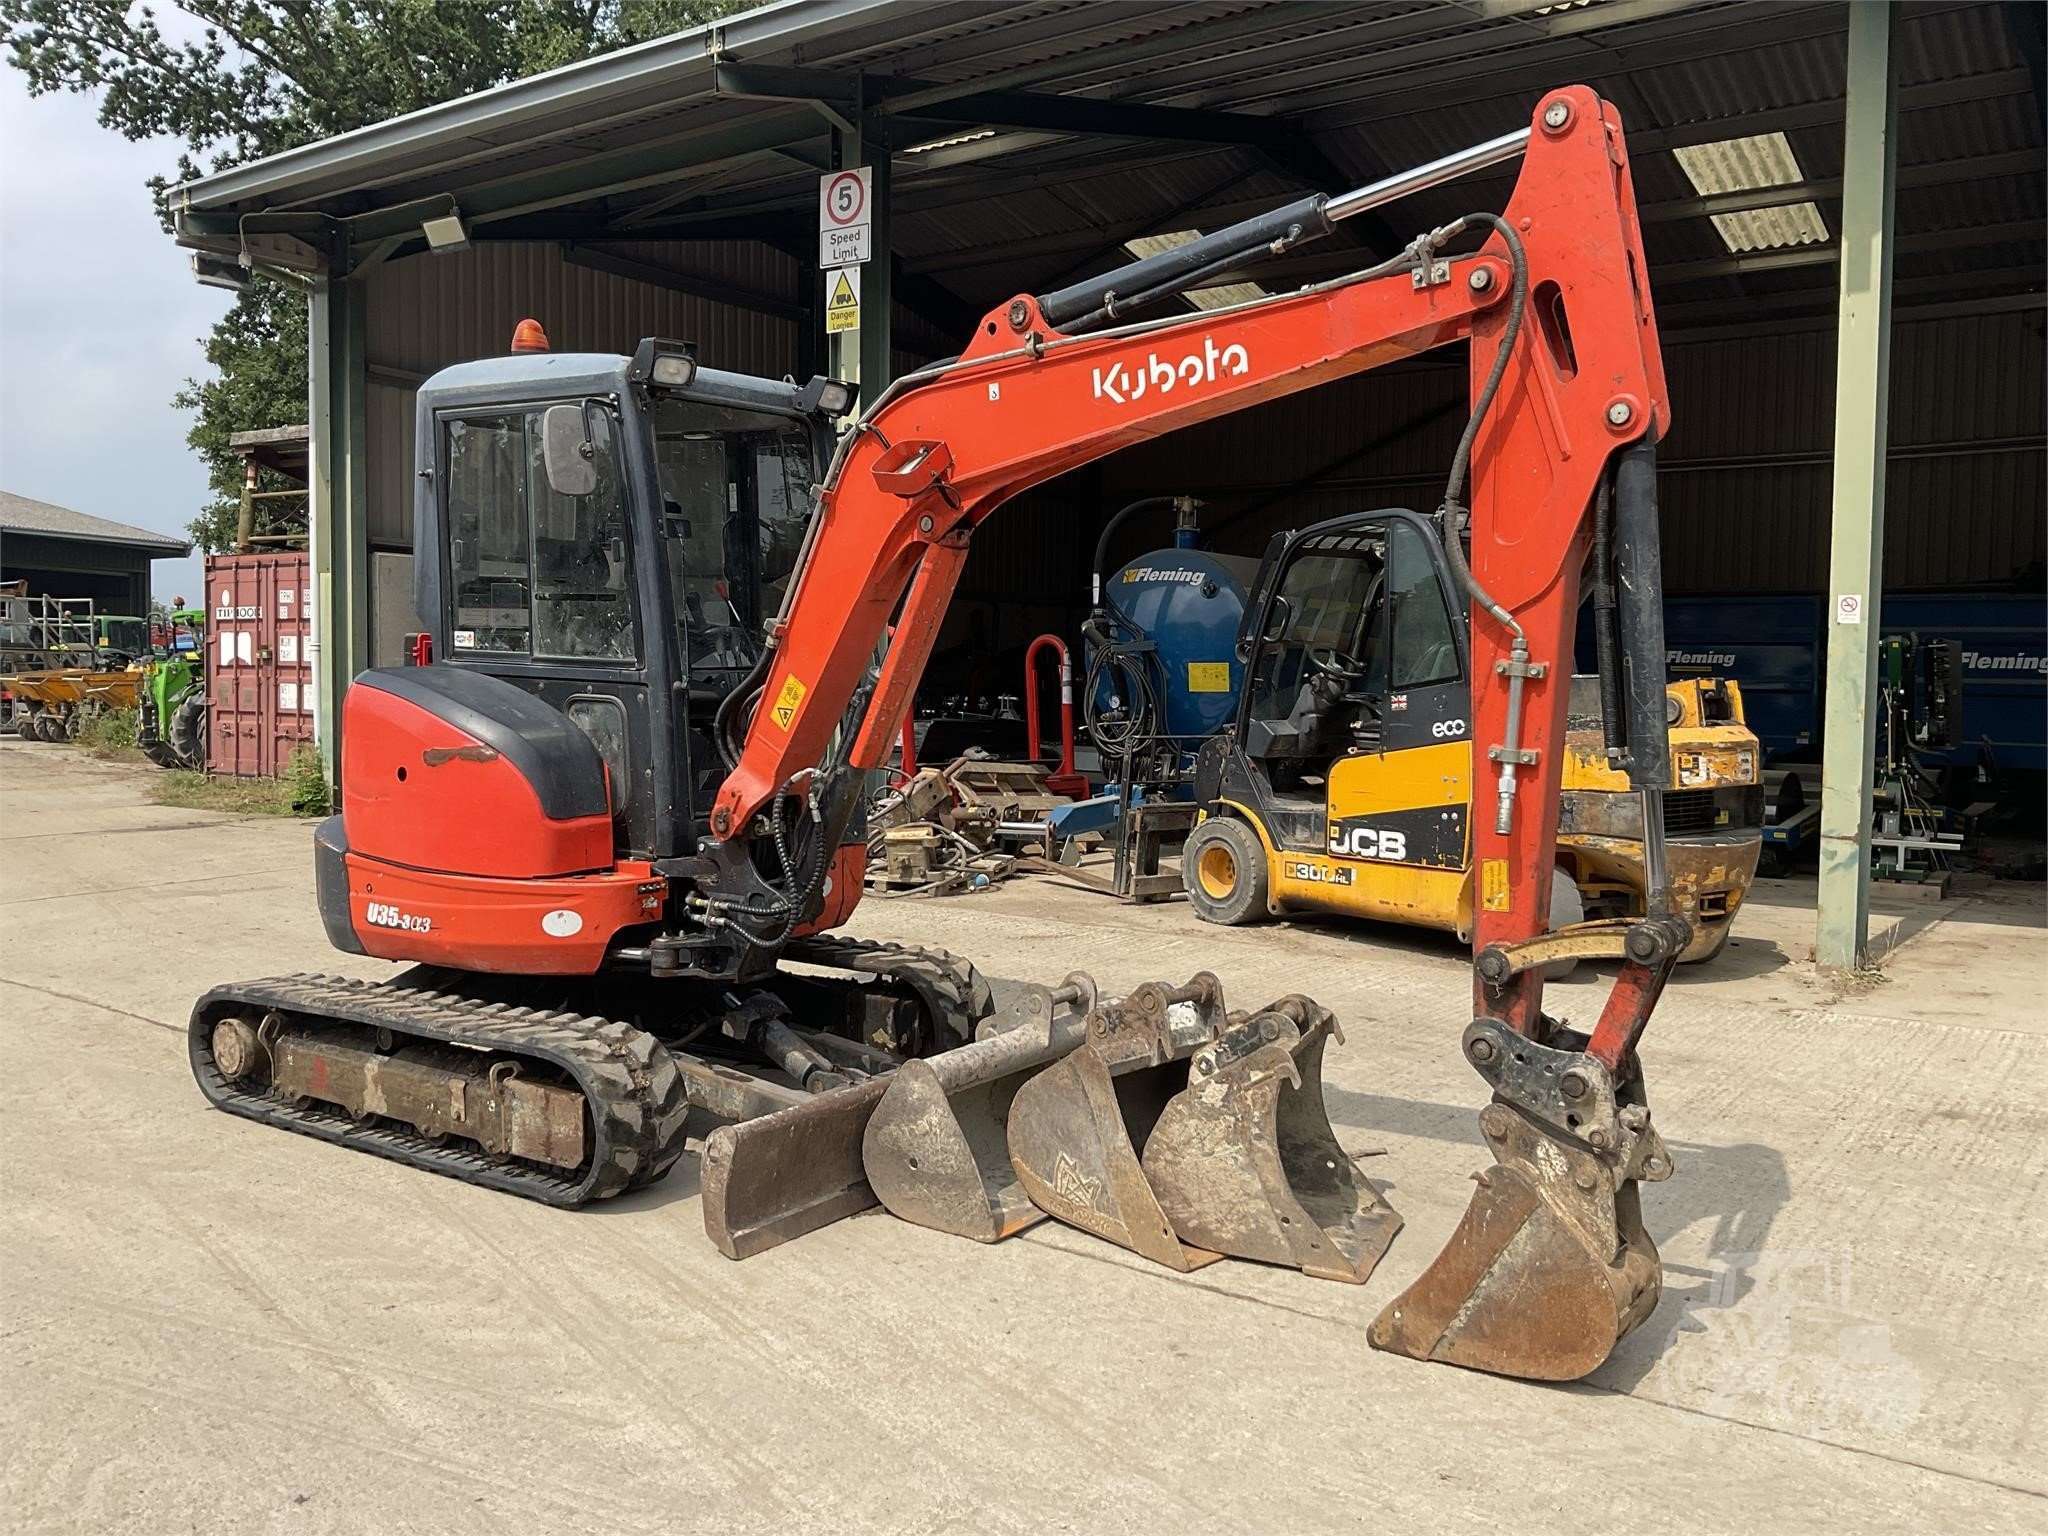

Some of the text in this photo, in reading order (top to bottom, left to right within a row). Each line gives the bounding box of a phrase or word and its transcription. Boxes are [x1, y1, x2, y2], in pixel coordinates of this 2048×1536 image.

[838, 185, 853, 212] 5
[830, 230, 861, 246] Speed
[832, 247, 858, 260] Limit
[830, 310, 857, 321] Danger
[1092, 335, 1249, 404] Kubota
[1135, 567, 1206, 586] Fleming
[1665, 650, 1736, 667] Fleming
[1329, 827, 1406, 860] JCB
